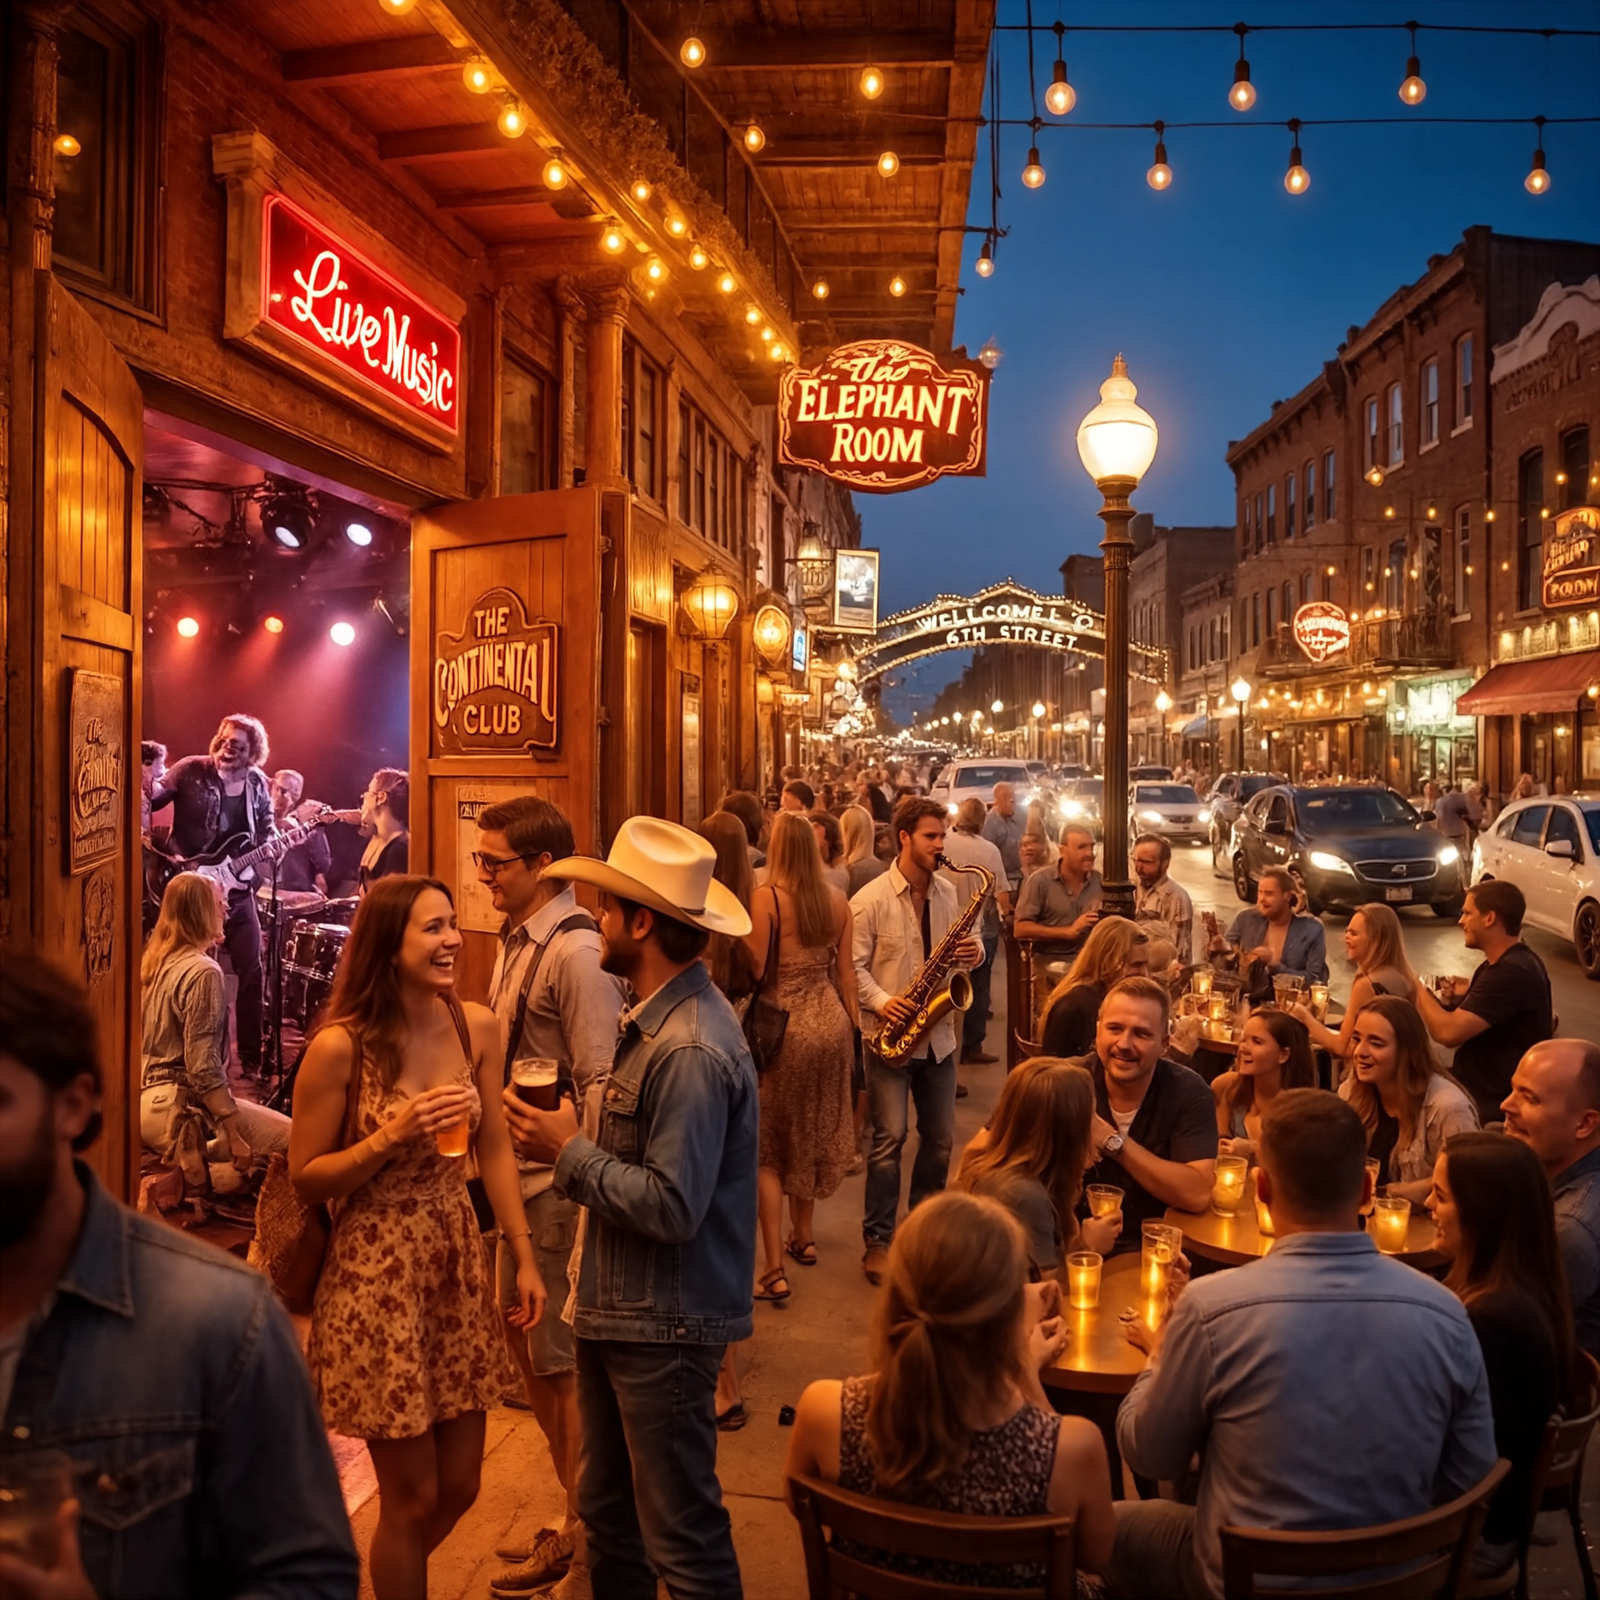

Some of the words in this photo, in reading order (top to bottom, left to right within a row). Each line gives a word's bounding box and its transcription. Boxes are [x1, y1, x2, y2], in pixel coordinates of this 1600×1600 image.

[291, 250, 382, 367] Live
[382, 306, 453, 412] Music
[797, 379, 974, 435] ELEPHANT
[830, 423, 924, 463] ROOM
[474, 606, 510, 637] THE
[946, 626, 986, 647] 6TH
[1000, 625, 1078, 650] STREET
[435, 637, 556, 727] CONTINENTAL
[463, 704, 523, 735] CLUB
